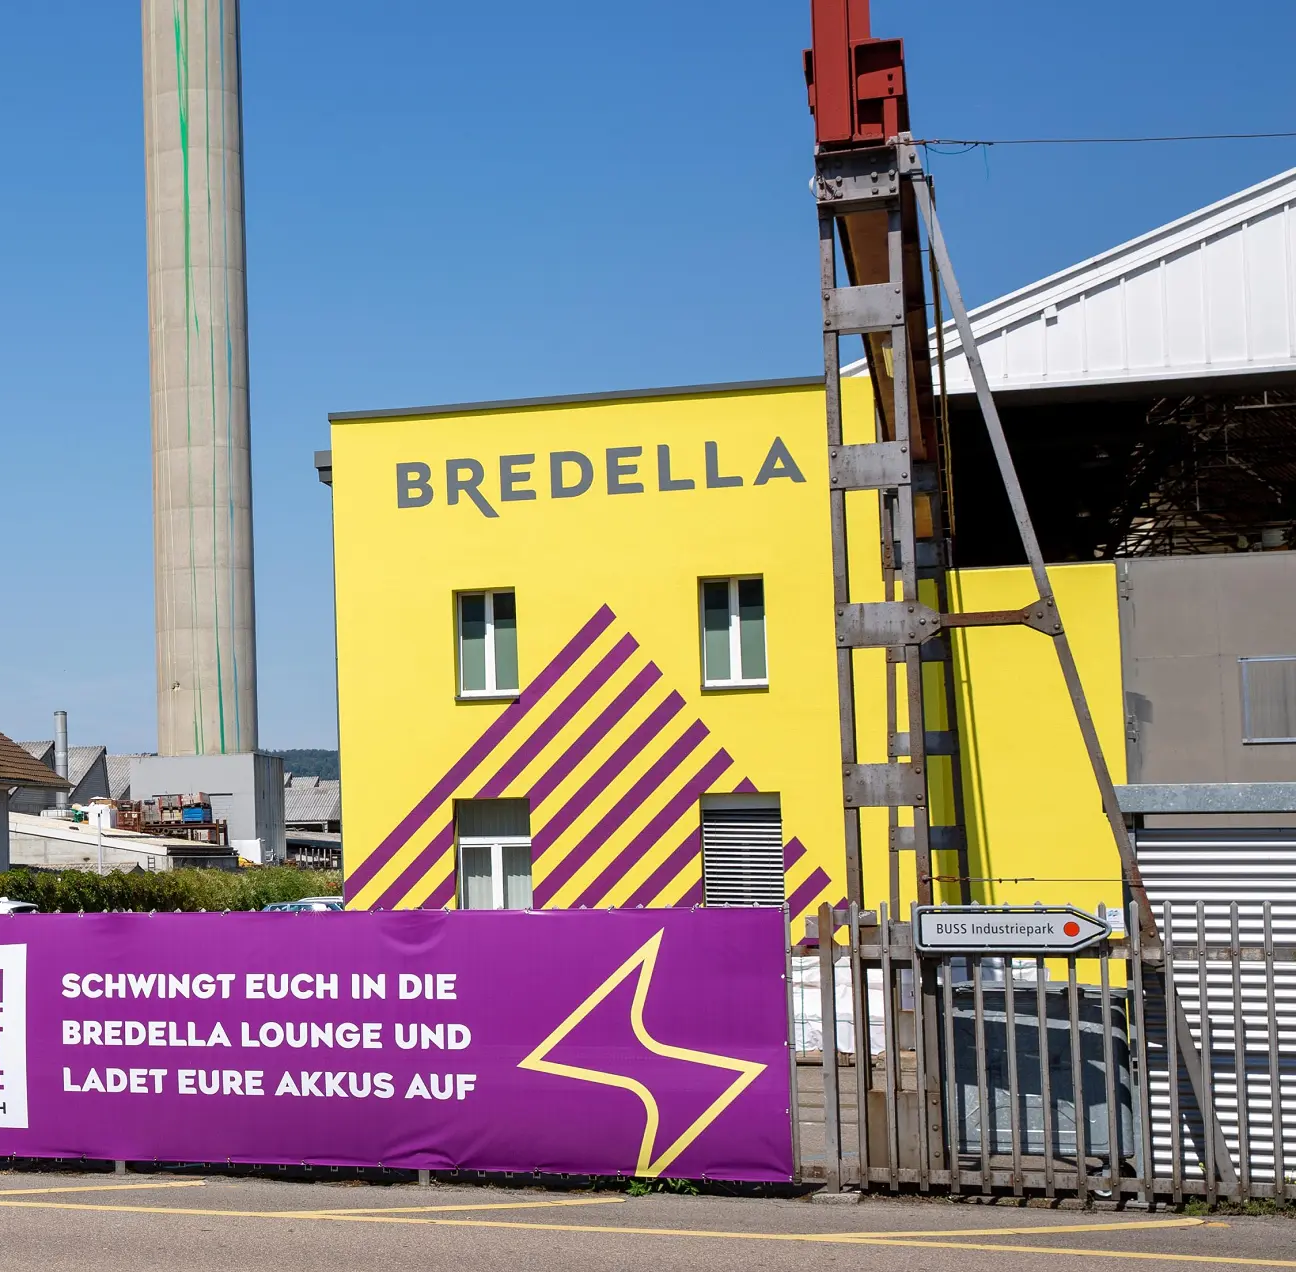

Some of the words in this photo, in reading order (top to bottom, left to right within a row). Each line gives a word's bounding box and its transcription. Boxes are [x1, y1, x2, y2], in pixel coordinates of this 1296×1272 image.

[396, 436, 807, 519] BREDELLA
[936, 923, 967, 935] BUSS
[971, 922, 1054, 937] Industriepark
[61, 972, 236, 1000] SCHWINGT
[245, 973, 339, 1000] EUCH
[351, 973, 386, 1000] IN
[398, 973, 457, 1000] DIE
[62, 1020, 232, 1047] BREDELLA
[241, 1021, 383, 1049] LOUNGE
[394, 1023, 472, 1050] UND
[63, 1067, 168, 1094] LADET
[177, 1069, 265, 1096] EURE
[274, 1070, 395, 1099] AKKUS
[404, 1073, 477, 1101] AUF
